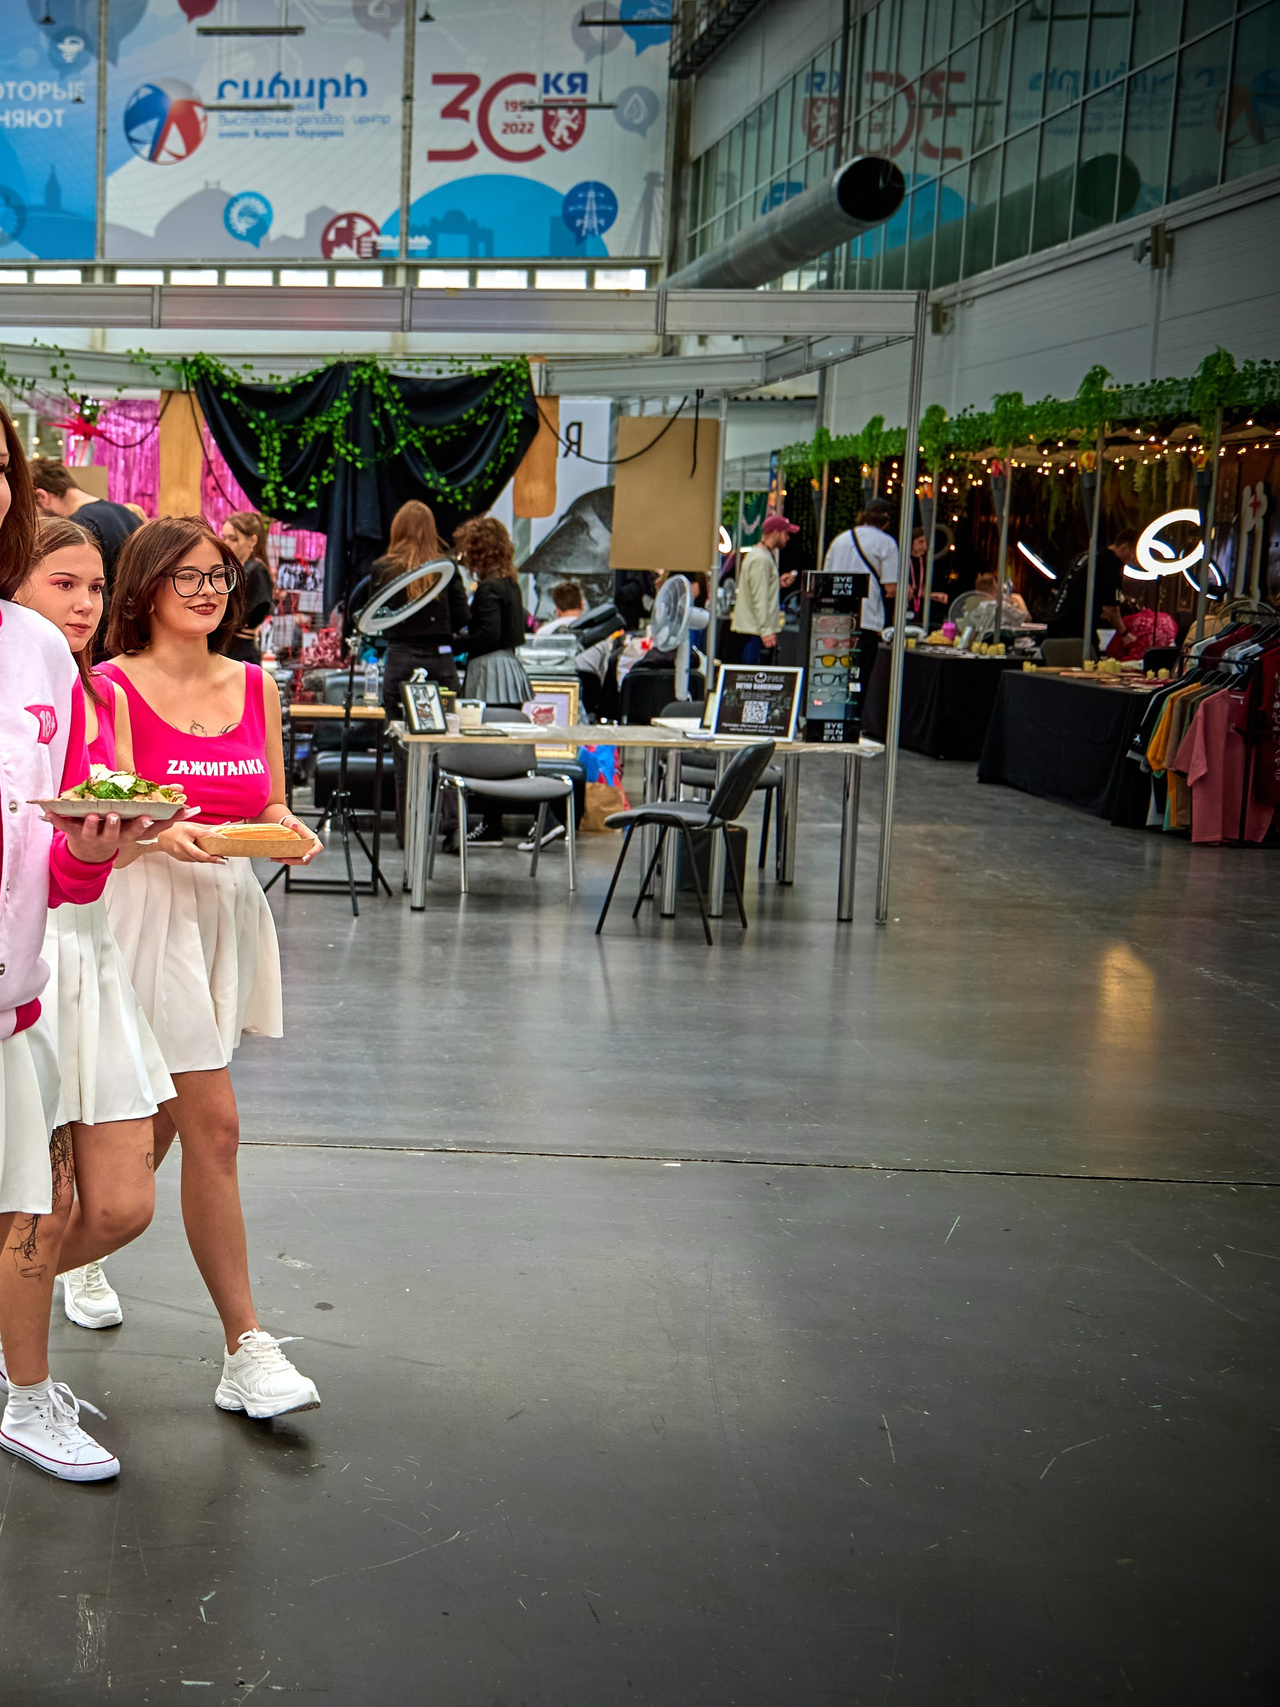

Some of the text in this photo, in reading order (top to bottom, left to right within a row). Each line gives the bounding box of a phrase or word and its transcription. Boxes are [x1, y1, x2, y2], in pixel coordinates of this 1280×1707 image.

[543, 72, 588, 95] КЯ
[501, 122, 535, 135] 2022
[40, 710, 55, 738] 18+
